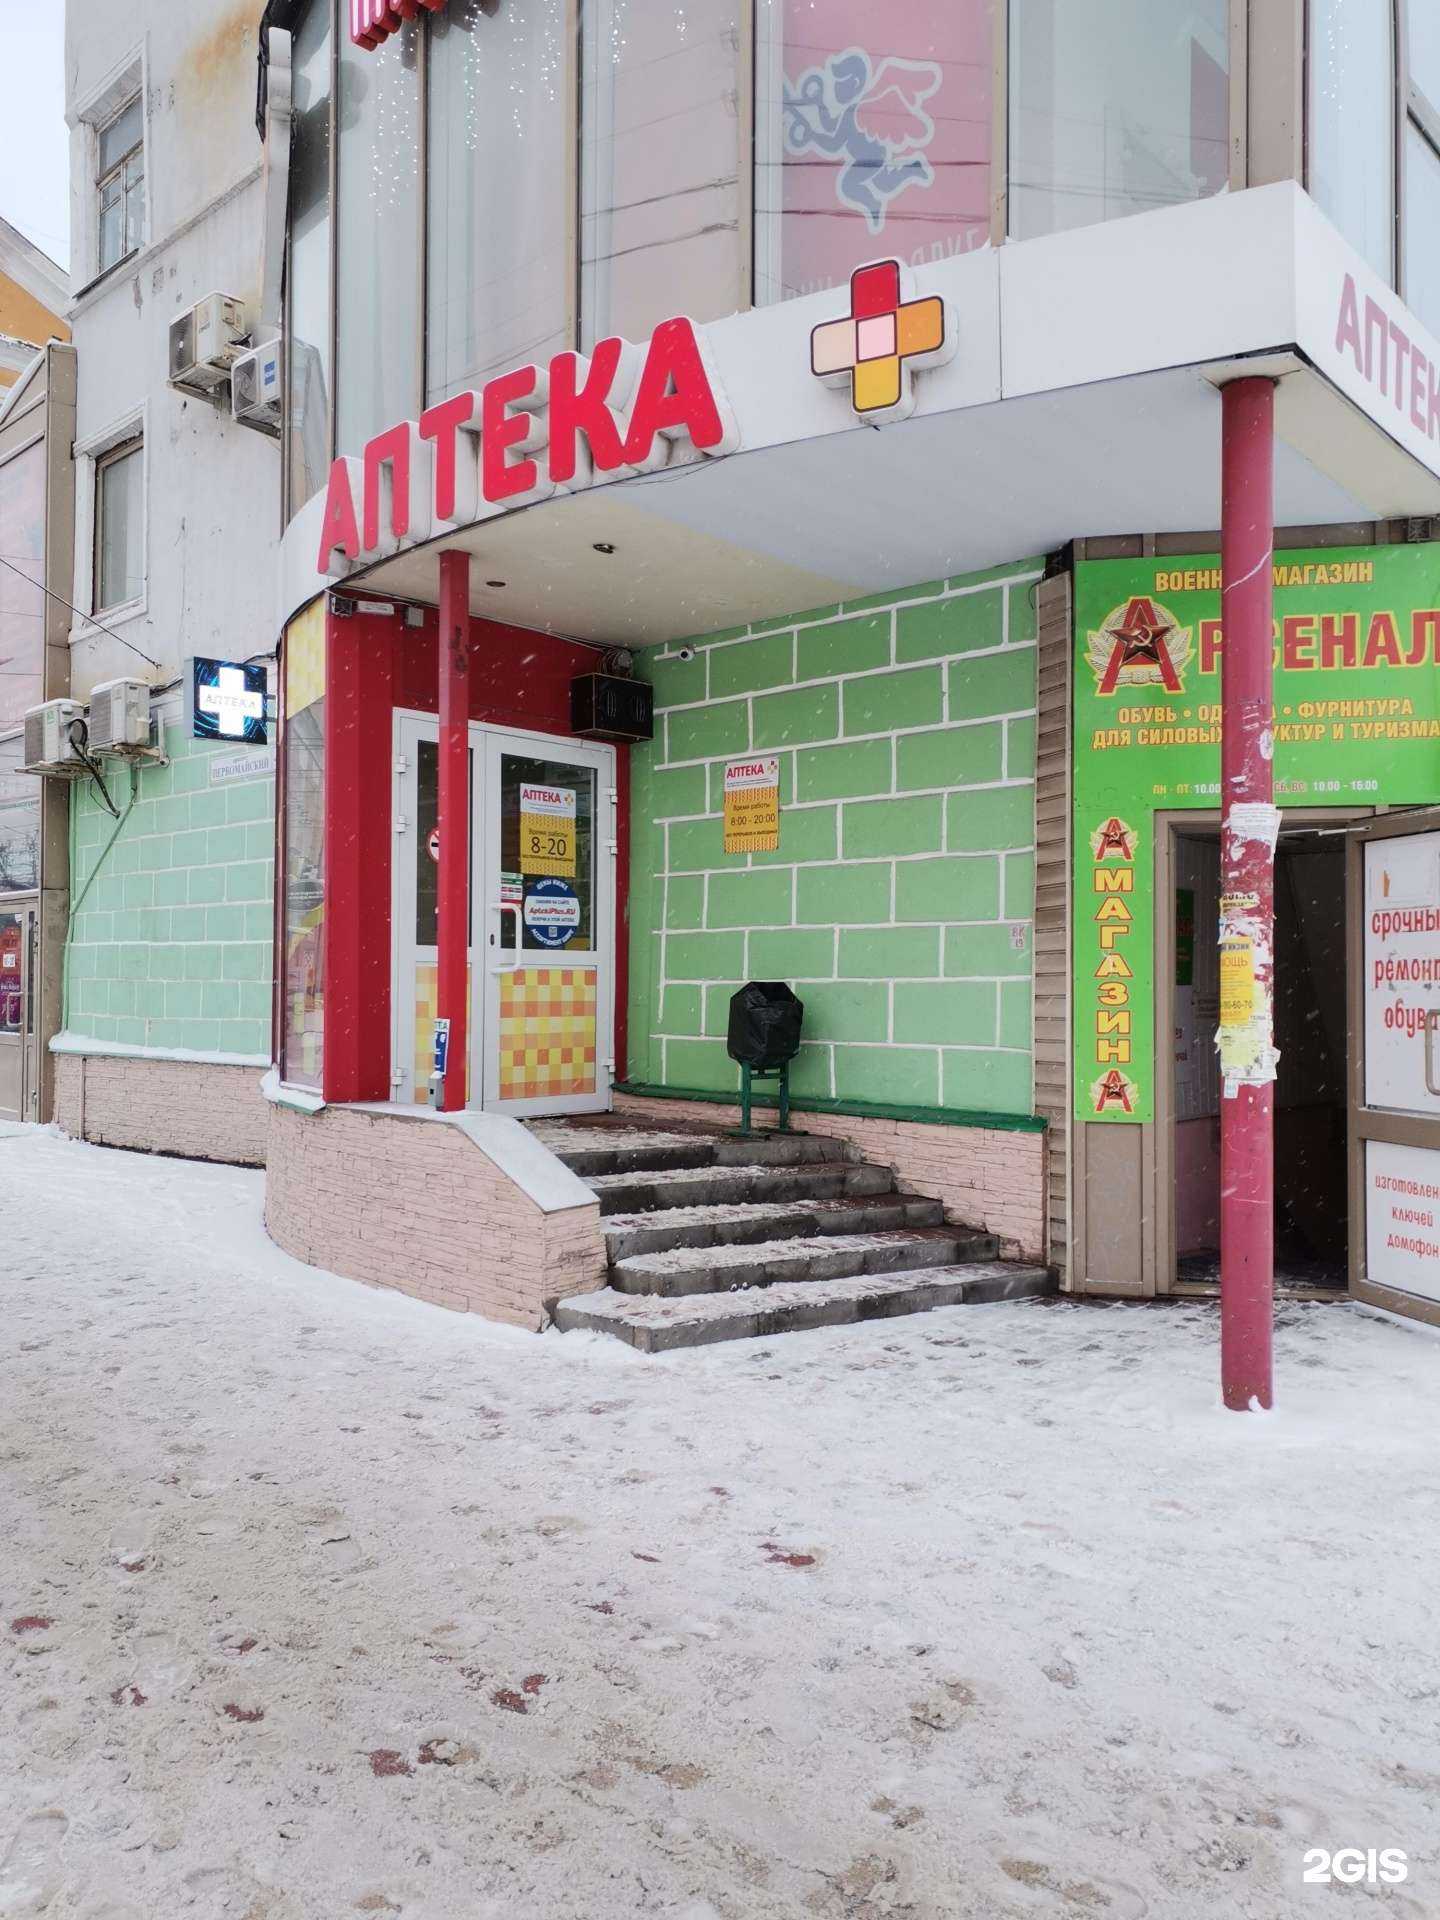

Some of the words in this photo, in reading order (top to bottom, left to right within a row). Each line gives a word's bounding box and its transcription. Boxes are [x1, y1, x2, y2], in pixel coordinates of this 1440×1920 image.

[318, 316, 724, 575] АПТЕКА
[1155, 569, 1222, 592] ВОЕНН
[1273, 561, 1374, 586] МАГАЗИН
[1095, 597, 1440, 697] АРЕНАЛ
[1119, 706, 1177, 724] ОБУВЬ
[1298, 698, 1413, 719] ФУРНИТУРА
[1093, 729, 1131, 749] ДЛЯ
[1332, 722, 1344, 740] И
[1350, 719, 1440, 739] ТУРИЗМА
[727, 763, 764, 779] АПТЕКА
[522, 788, 562, 804] АПТЕКА
[531, 836, 567, 856] 8-20
[1094, 868, 1134, 1064] МАГАЗИН
[1392, 1206, 1433, 1228] ключей
